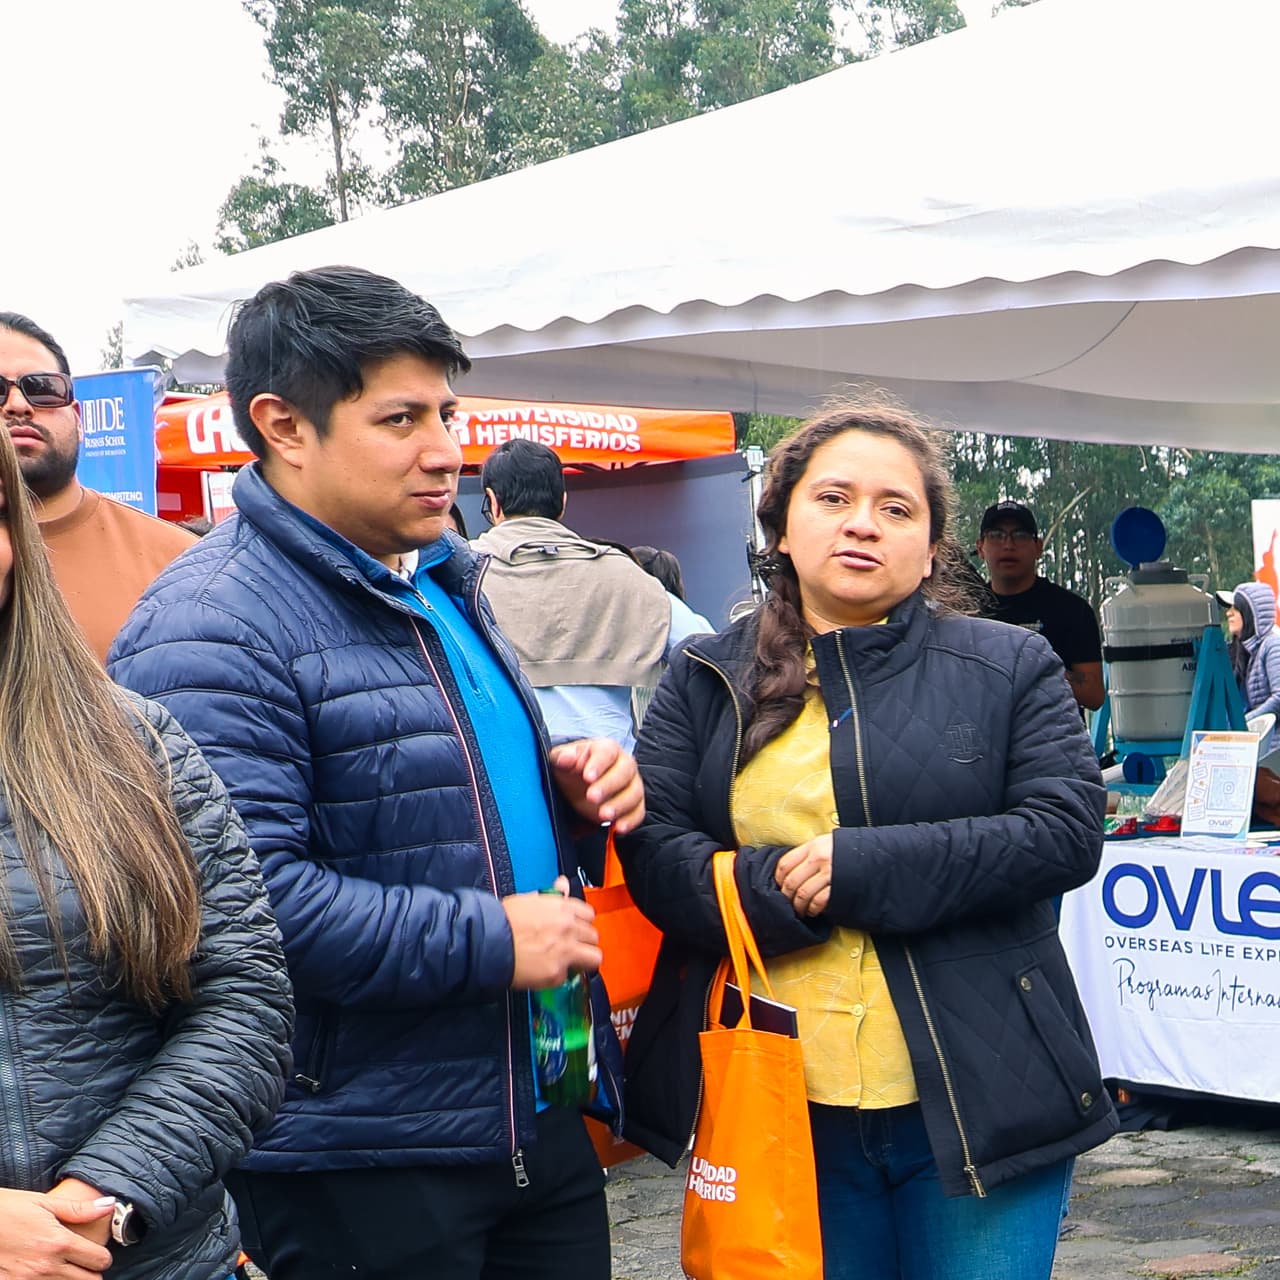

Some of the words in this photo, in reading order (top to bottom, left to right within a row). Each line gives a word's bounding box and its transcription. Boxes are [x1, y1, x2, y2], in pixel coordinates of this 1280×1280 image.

[475, 423, 642, 453] HEMISFERIOS
[1104, 935, 1194, 954] OVERSEAS
[1200, 942, 1235, 958] LIFE
[1112, 957, 1213, 1011] Programas
